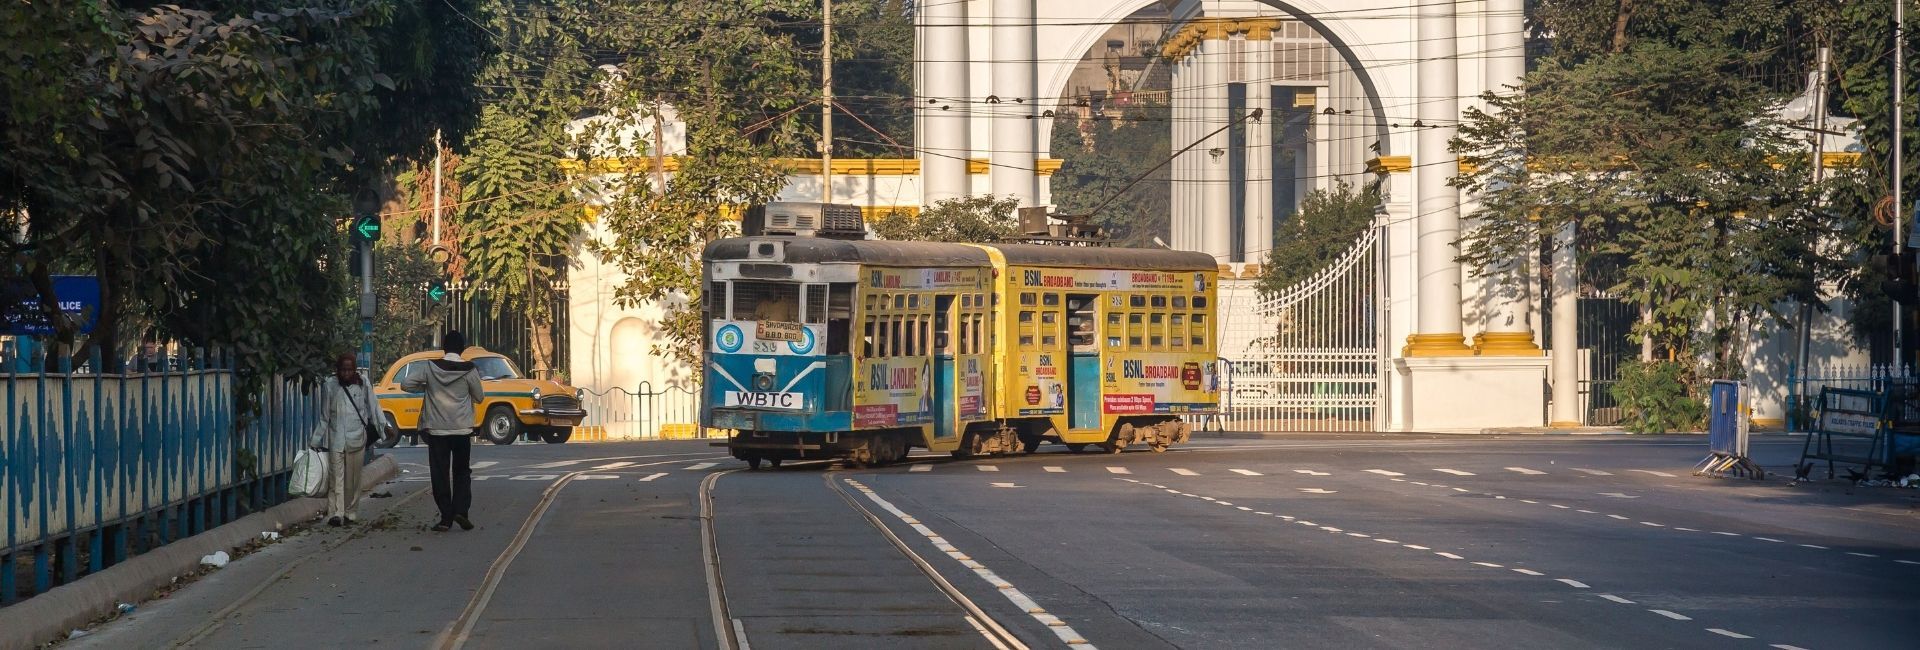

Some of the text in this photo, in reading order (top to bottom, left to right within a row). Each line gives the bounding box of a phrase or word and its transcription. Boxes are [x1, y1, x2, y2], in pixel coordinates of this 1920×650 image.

[1024, 270, 1043, 287] BSNL
[1044, 275, 1074, 288] BROADBAND
[1123, 359, 1145, 379] BSNL
[1145, 366, 1179, 379] BROADBAND
[736, 392, 793, 408] WBTC
